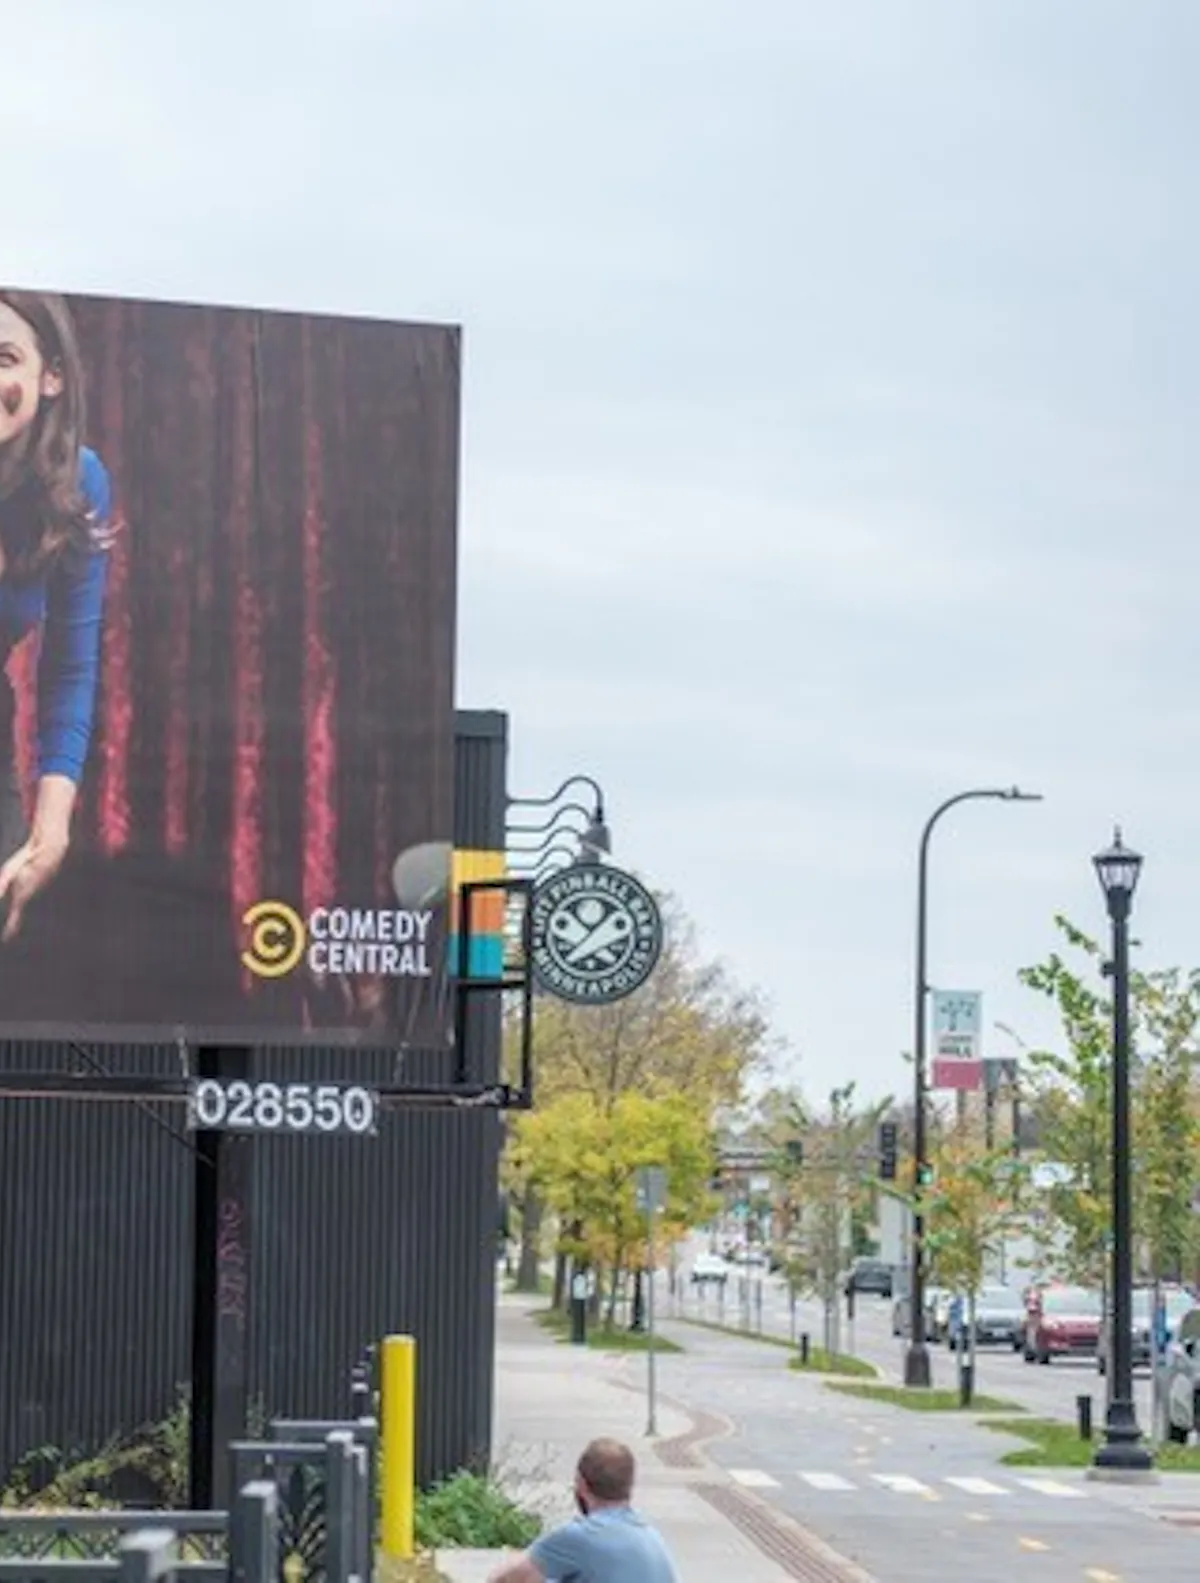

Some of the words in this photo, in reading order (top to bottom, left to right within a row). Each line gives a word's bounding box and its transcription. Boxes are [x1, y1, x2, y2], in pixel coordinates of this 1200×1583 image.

[309, 906, 432, 941] COMEDY
[308, 941, 432, 976] CENTRAL
[195, 1079, 374, 1132] 028550
